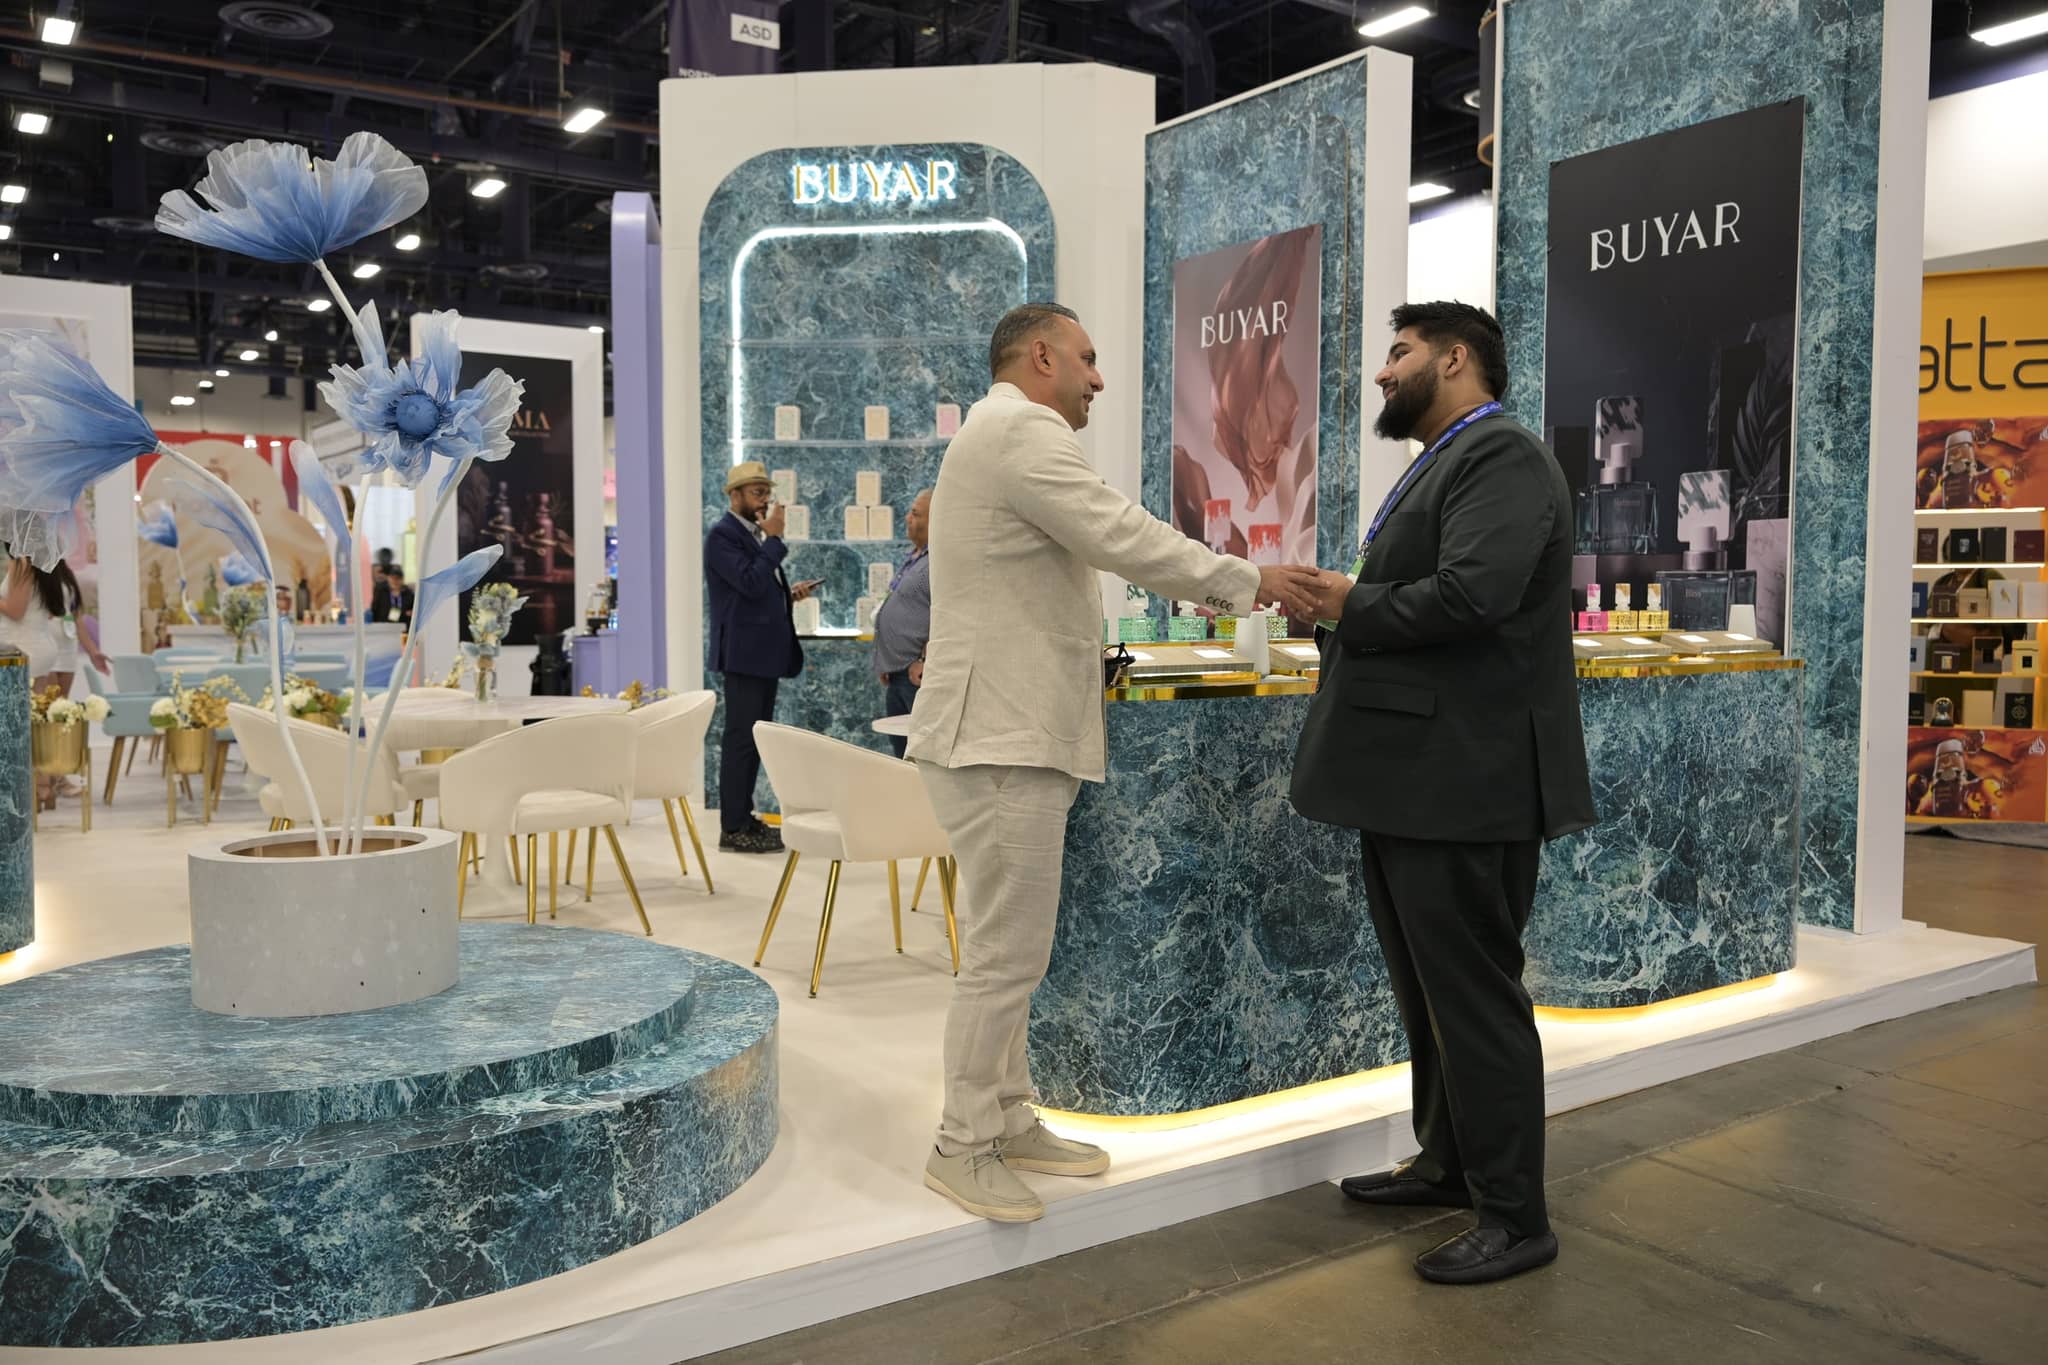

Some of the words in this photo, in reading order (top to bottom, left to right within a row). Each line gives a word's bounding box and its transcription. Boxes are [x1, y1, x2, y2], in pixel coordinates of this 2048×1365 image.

[739, 23, 773, 41] ASD
[793, 160, 957, 204] BUYAR
[1590, 202, 1741, 272] BUYAR
[1201, 300, 1288, 349] BUYAR
